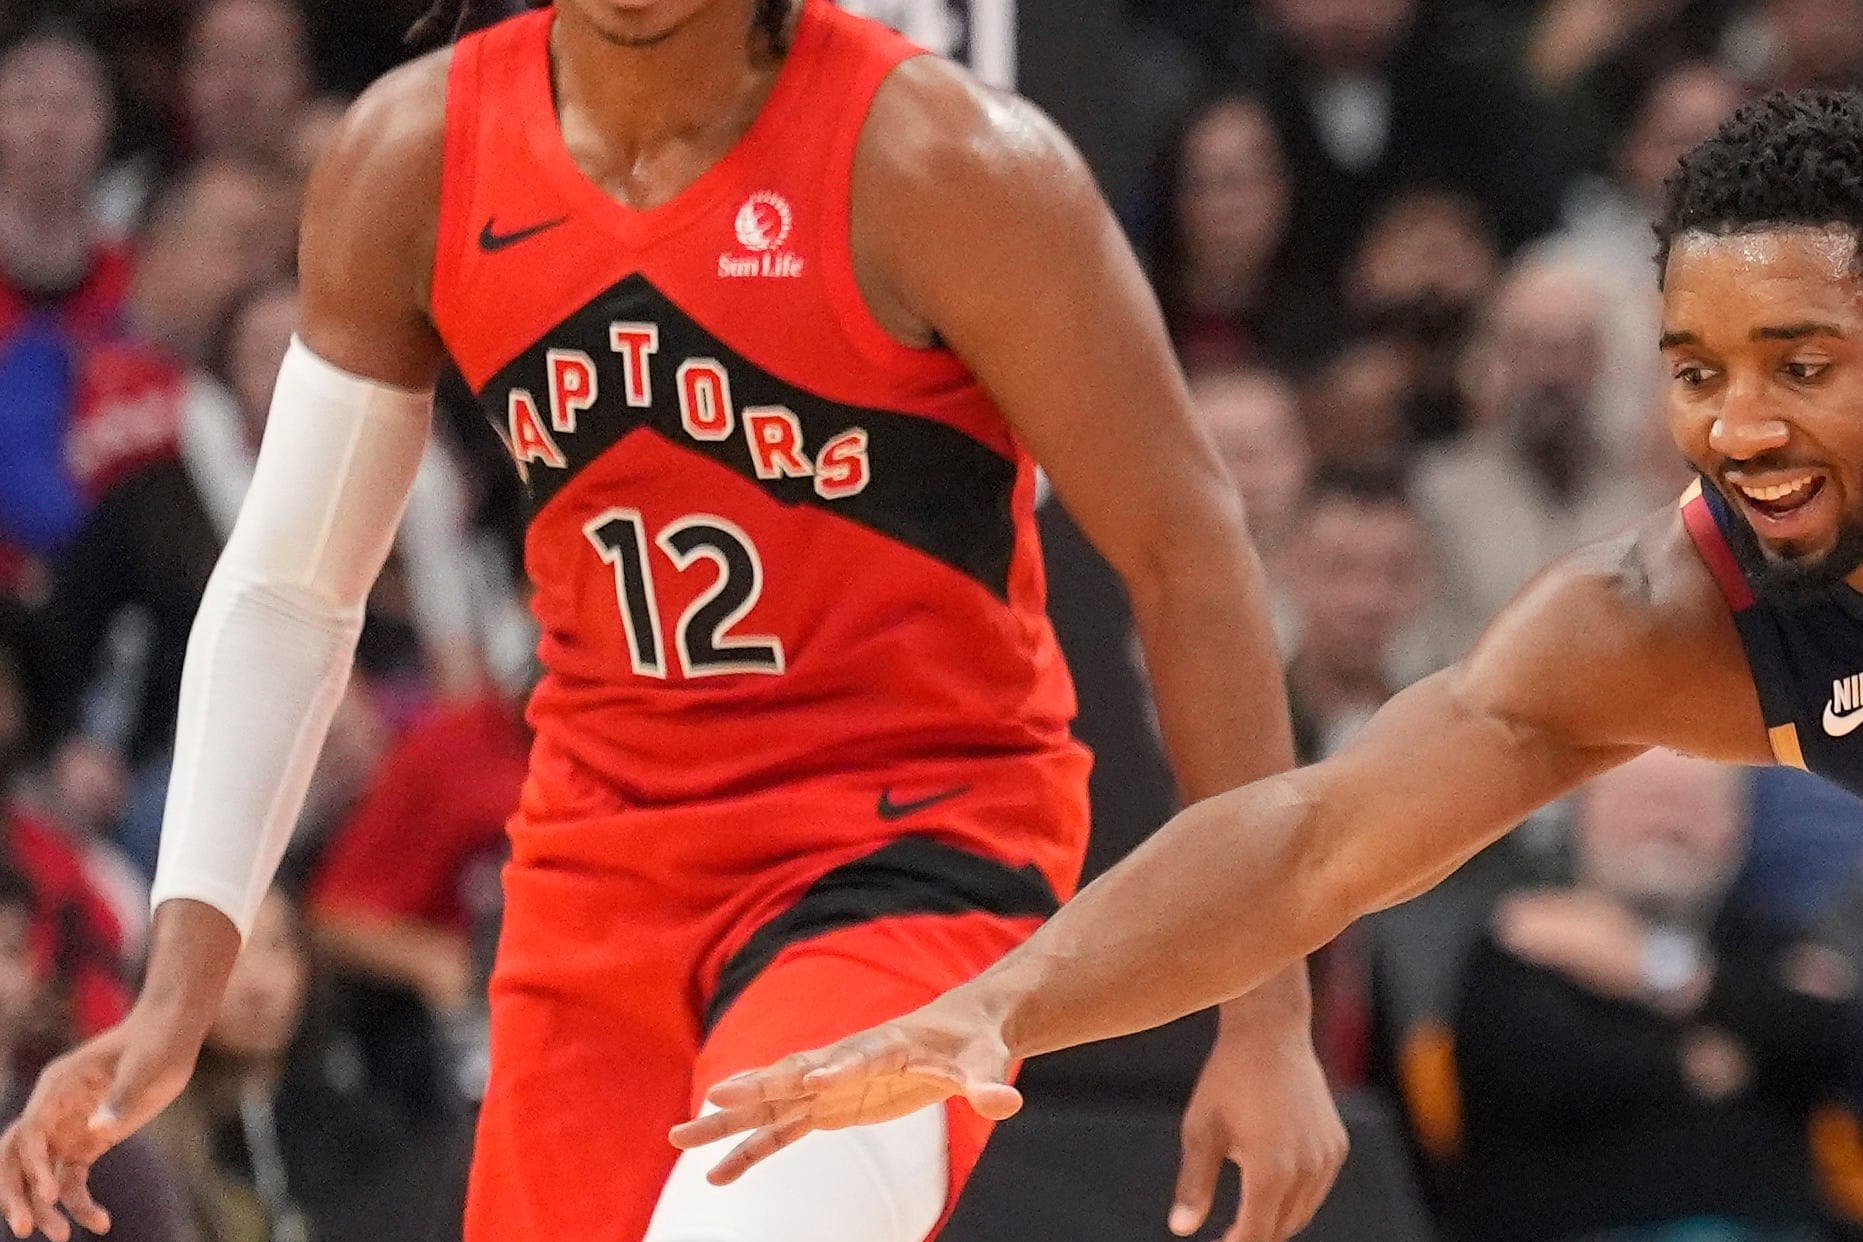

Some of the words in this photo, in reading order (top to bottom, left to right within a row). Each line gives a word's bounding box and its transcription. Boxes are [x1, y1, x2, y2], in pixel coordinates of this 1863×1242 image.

[717, 252, 760, 278] Sun
[761, 250, 804, 278] Life
[485, 320, 871, 500] APTORS
[583, 506, 786, 678] 12
